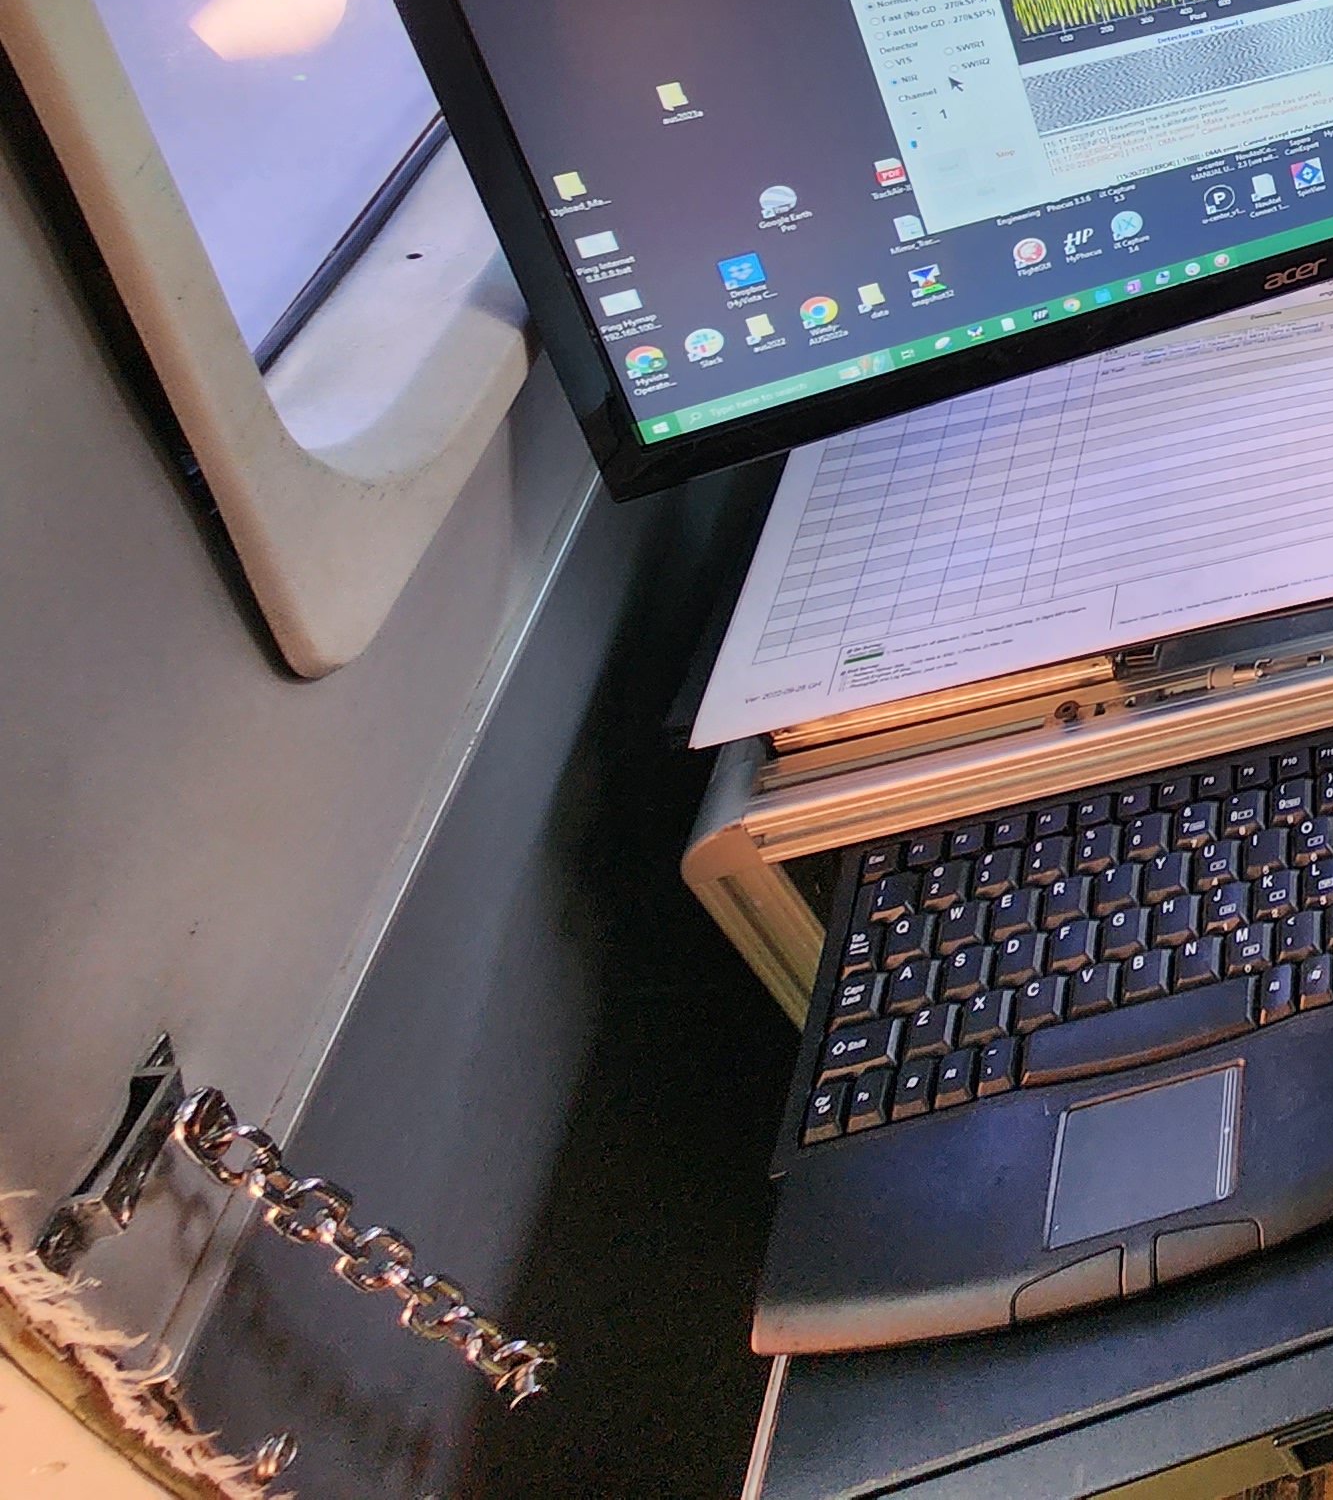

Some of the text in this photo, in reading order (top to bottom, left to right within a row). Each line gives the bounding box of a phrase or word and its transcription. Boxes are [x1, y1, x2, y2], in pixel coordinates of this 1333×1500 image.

[879, 40, 919, 55] Detector
[956, 40, 985, 53] SWIR1
[895, 56, 913, 67] VIS
[961, 57, 990, 71] SWIR2
[901, 74, 919, 84] NIR
[898, 88, 938, 103] Channel
[939, 109, 948, 120] 1
[881, 169, 902, 181] PDF
[758, 210, 813, 230] Google Earth
[996, 208, 1041, 226] Engineering
[781, 222, 797, 234] Pro
[1017, 261, 1052, 277] FlightGUI
[1263, 257, 1328, 291] acer
[871, 307, 890, 319] data
[700, 355, 723, 370] Slack
[1123, 796, 1134, 804] F6
[997, 825, 1010, 834] F3
[1301, 822, 1312, 834] O
[1252, 835, 1258, 846] I
[912, 844, 924, 853] F1
[1203, 845, 1214, 857] U
[1156, 857, 1167, 869] Y
[1105, 870, 1115, 882] T
[1311, 864, 1320, 876] L
[1262, 875, 1273, 888] K
[1053, 882, 1065, 895] R
[1213, 889, 1221, 901] J
[1001, 895, 1013, 907] E
[1162, 900, 1174, 913] H
[950, 906, 964, 920] W
[1112, 913, 1125, 926] G
[896, 920, 909, 933] Q
[1059, 927, 1070, 940] F
[1236, 928, 1248, 943] M
[1007, 940, 1019, 953] D
[1185, 942, 1197, 955] N
[955, 953, 967, 967] S
[1133, 956, 1144, 970] B
[900, 966, 912, 980] A
[1081, 969, 1094, 982] V
[1027, 983, 1039, 996] C
[972, 996, 986, 1010] X
[916, 1011, 930, 1025] Z
